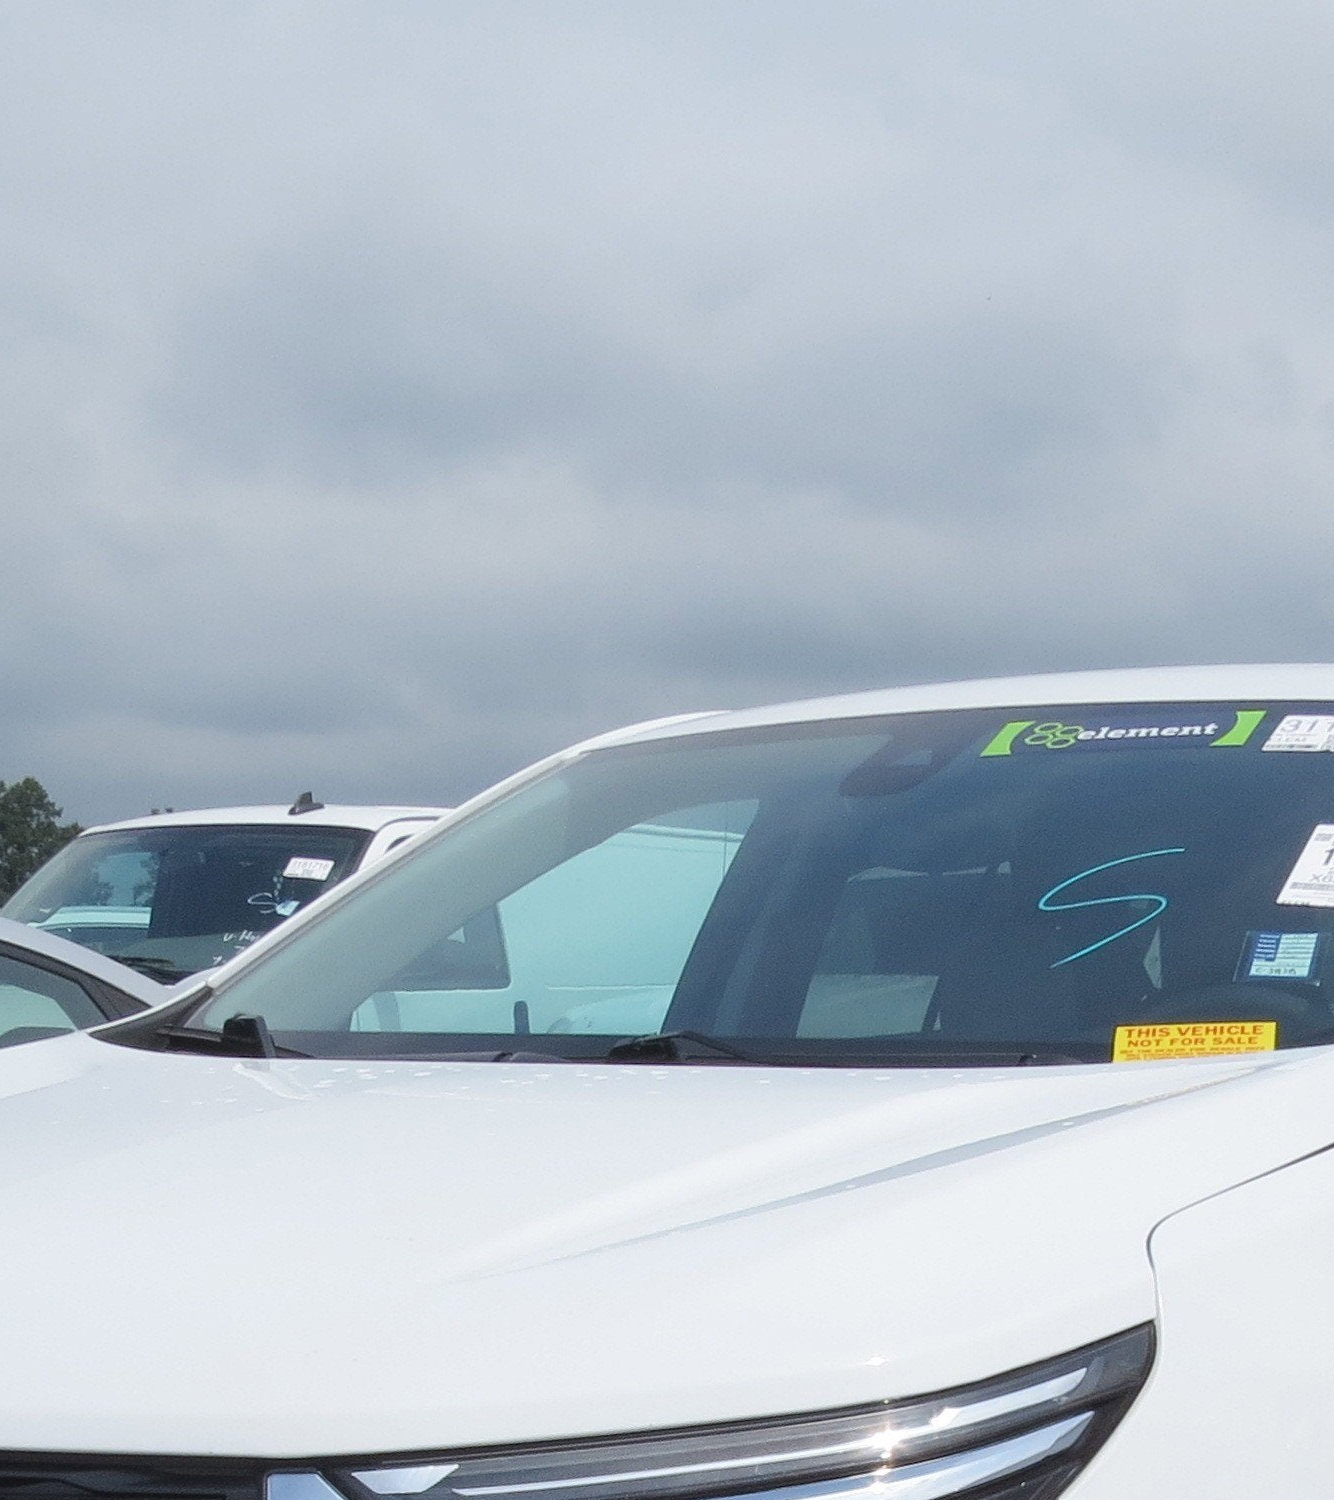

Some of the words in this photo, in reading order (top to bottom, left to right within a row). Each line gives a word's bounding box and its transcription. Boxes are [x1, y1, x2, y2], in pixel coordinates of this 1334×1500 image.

[1077, 722, 1219, 741] element
[1125, 1027, 1171, 1039] THIS
[1176, 1024, 1264, 1037] VEHICLE
[1127, 1039, 1165, 1048] NOT
[1169, 1037, 1205, 1046] FOR
[1212, 1036, 1259, 1045] SALE
